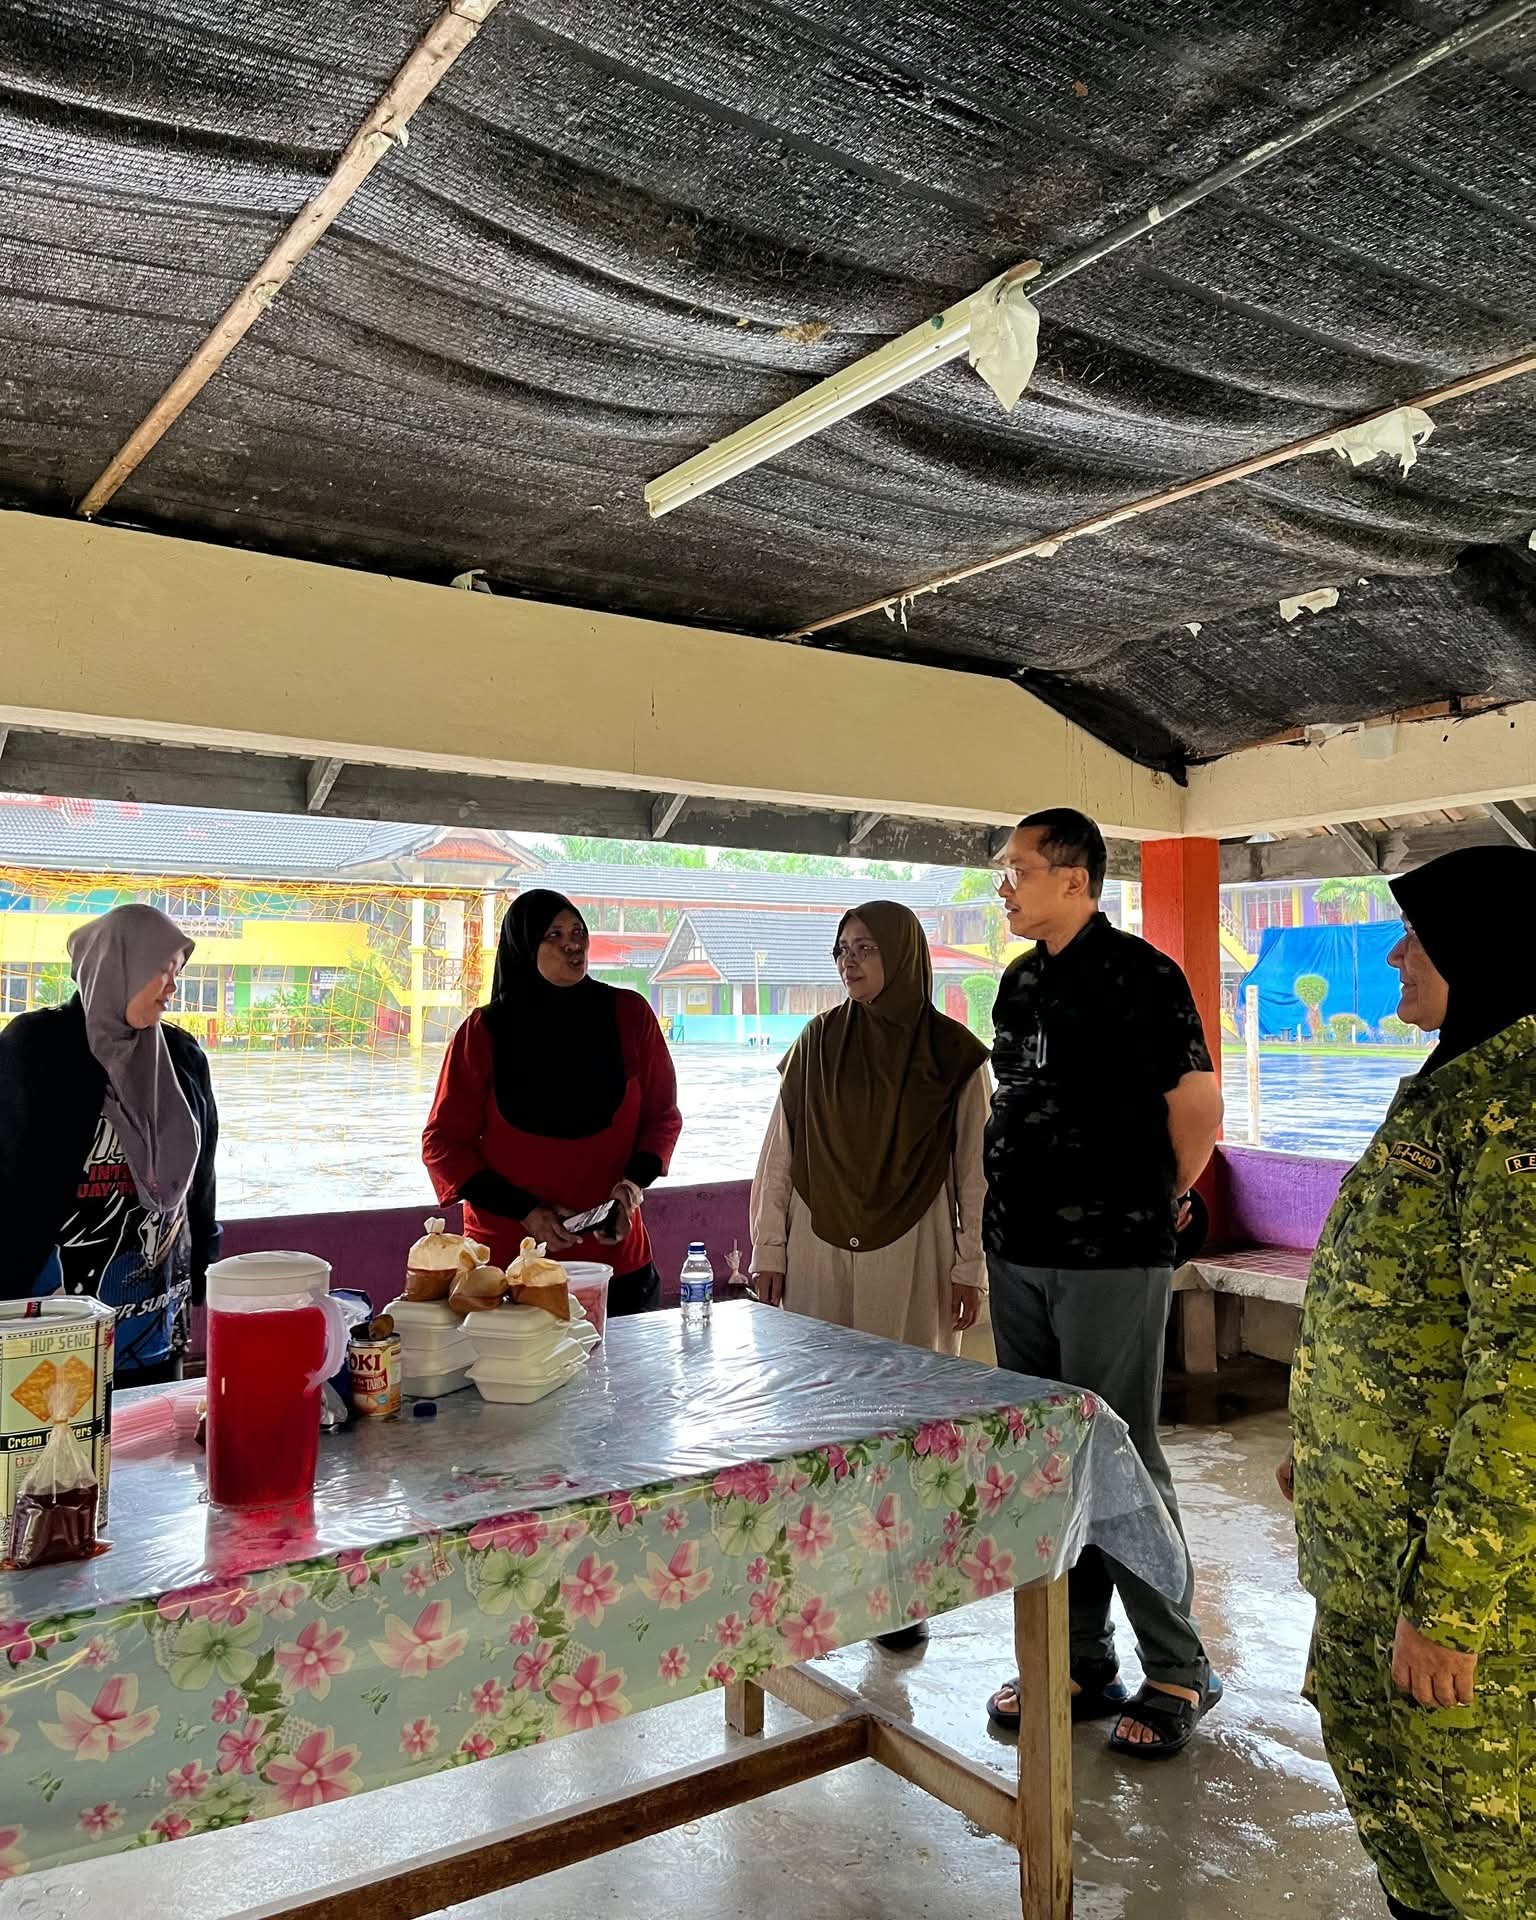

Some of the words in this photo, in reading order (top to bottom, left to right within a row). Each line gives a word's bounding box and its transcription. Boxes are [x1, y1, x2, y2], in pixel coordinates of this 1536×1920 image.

[30, 1337, 54, 1354] HUP
[58, 1333, 90, 1350] SENG
[8, 1434, 42, 1449] Cream
